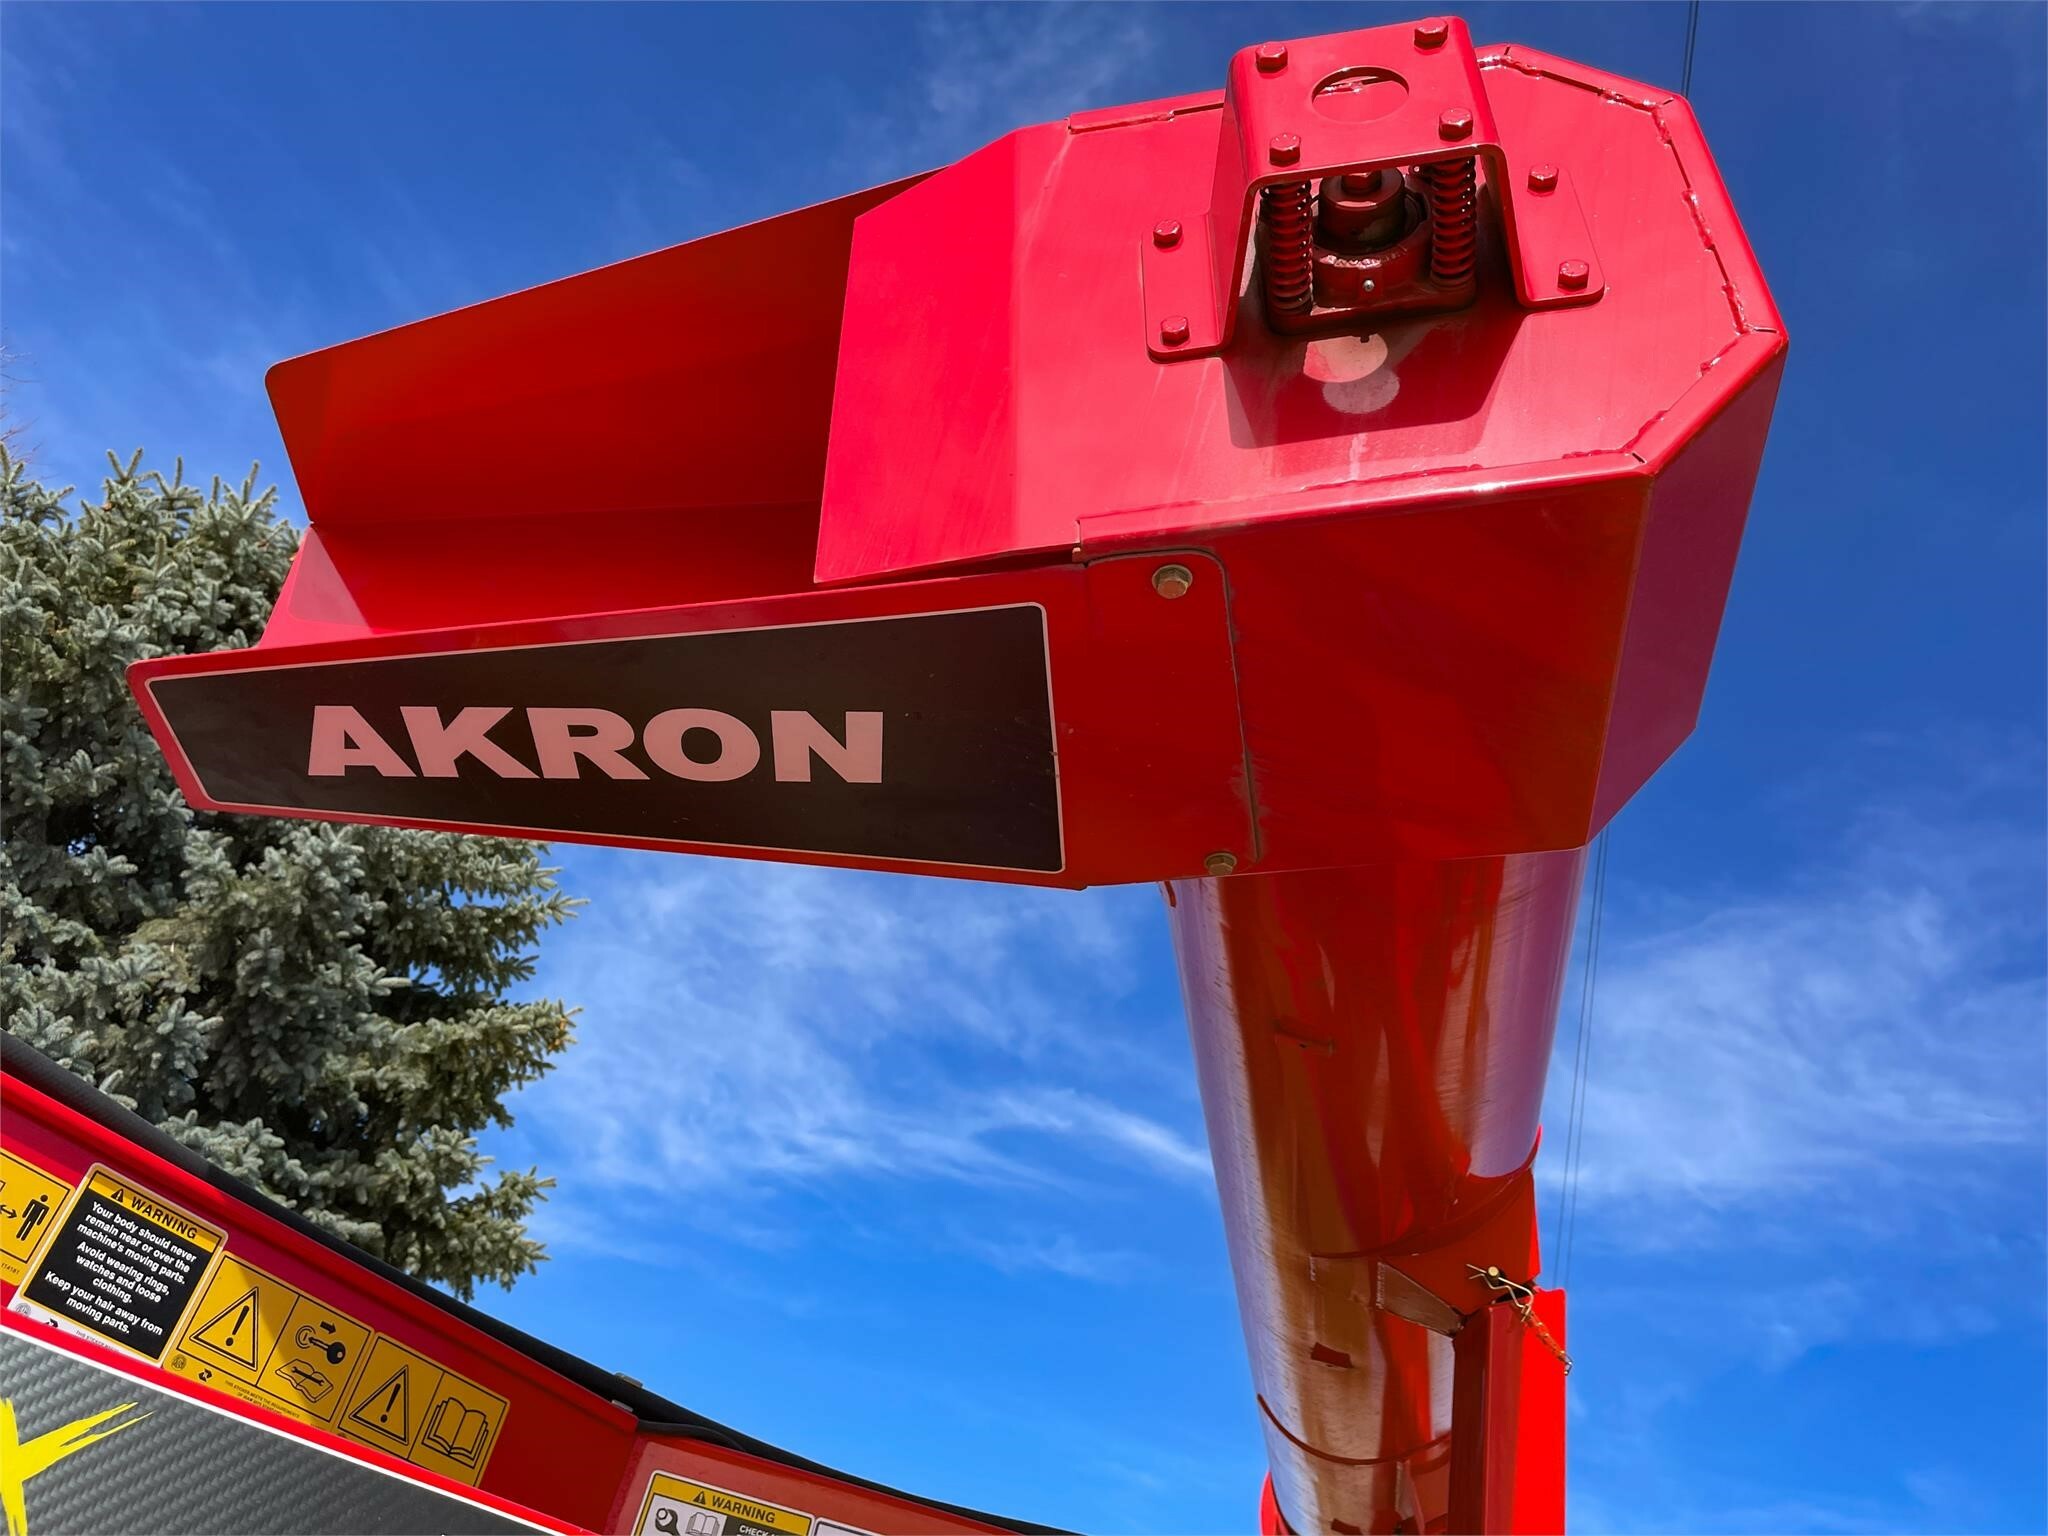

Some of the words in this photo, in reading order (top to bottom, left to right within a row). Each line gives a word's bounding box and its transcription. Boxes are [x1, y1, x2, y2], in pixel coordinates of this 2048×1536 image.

[308, 705, 883, 783] AKRON
[85, 1214, 119, 1236] remain
[119, 1231, 142, 1247] near
[141, 1243, 154, 1253] or
[153, 1249, 175, 1264] over
[175, 1258, 190, 1273] the
[92, 1201, 114, 1219] Your
[113, 1214, 138, 1233] body
[139, 1228, 171, 1249] should
[170, 1245, 197, 1263] never
[132, 1196, 198, 1239] WARNING
[76, 1255, 116, 1280] watches
[116, 1276, 136, 1290] and
[135, 1283, 161, 1303] loose
[77, 1223, 124, 1252] machine's
[125, 1248, 159, 1272] moving
[158, 1265, 185, 1285] parts.
[77, 1241, 107, 1261] Avoid
[106, 1256, 144, 1282] wearing
[143, 1276, 170, 1295] rings,
[45, 1270, 71, 1291] Keep
[70, 1285, 95, 1301] your
[94, 1295, 115, 1311] hair
[115, 1307, 140, 1325] away
[140, 1317, 163, 1336] from
[66, 1297, 103, 1321] moving
[102, 1315, 130, 1334] parts.
[92, 1277, 132, 1303] clothing.
[712, 1495, 776, 1523] WARNING
